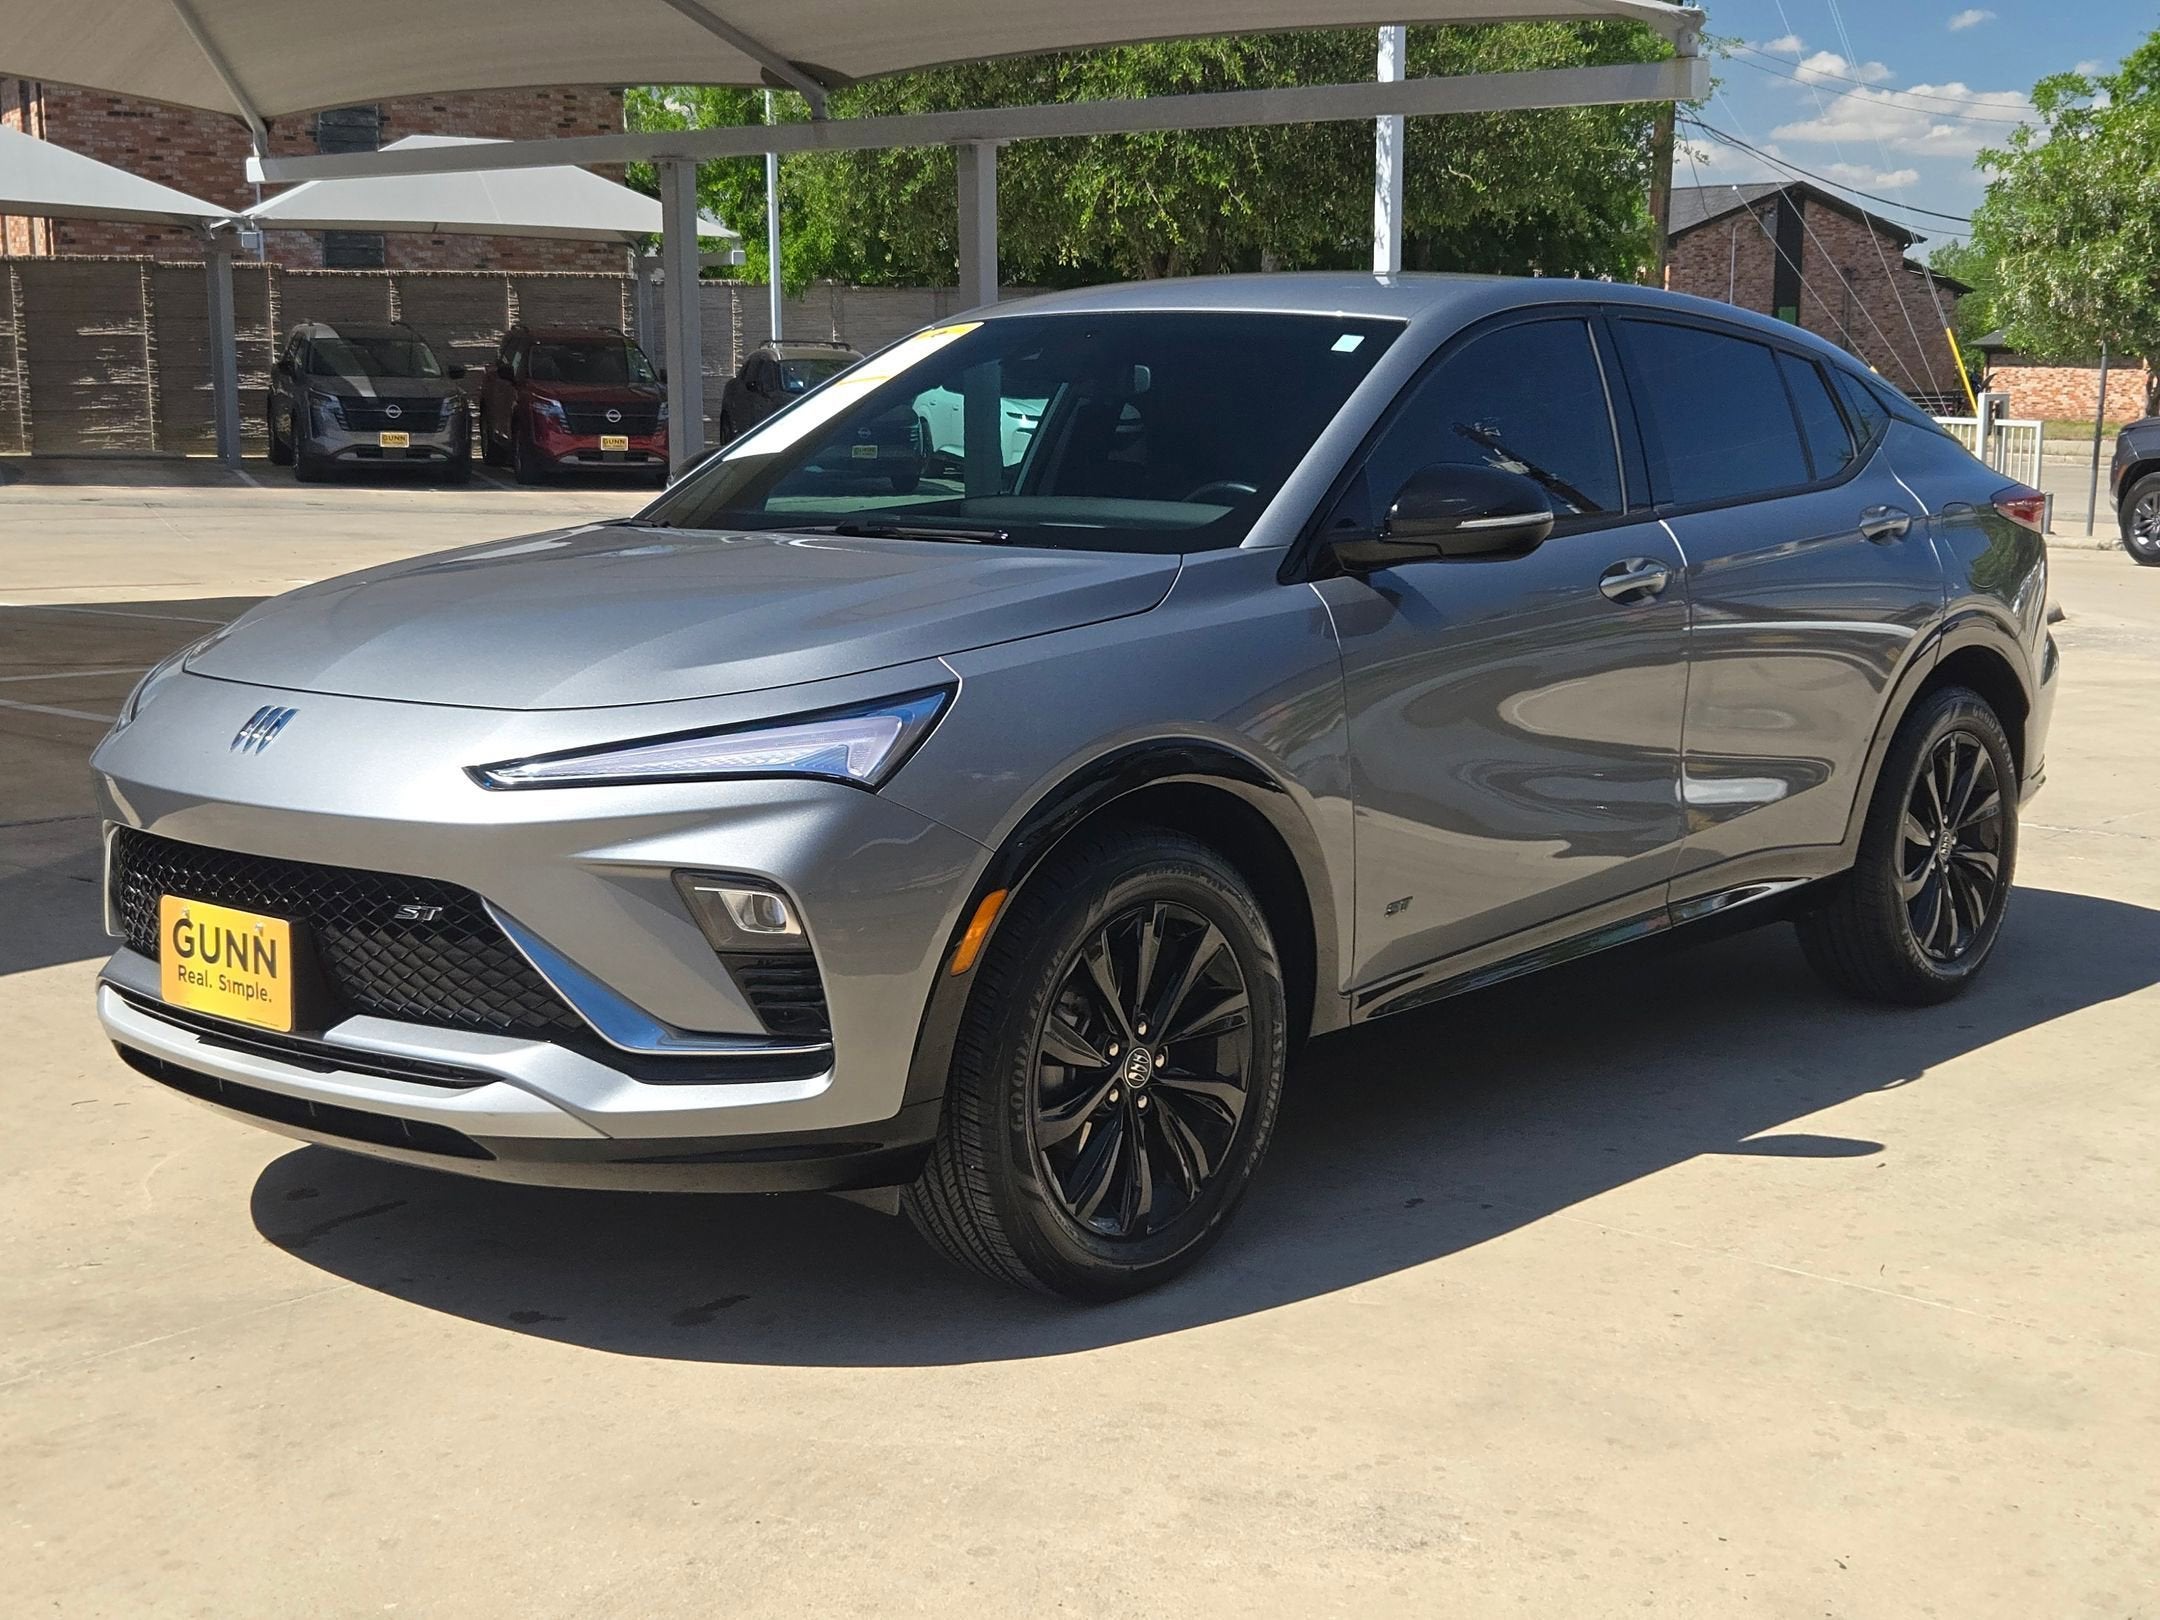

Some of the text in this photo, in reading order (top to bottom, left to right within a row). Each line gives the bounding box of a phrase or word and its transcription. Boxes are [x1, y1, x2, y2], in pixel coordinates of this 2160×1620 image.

[394, 904, 443, 921] ST
[172, 918, 277, 979] GUNN
[178, 964, 213, 989] Real.
